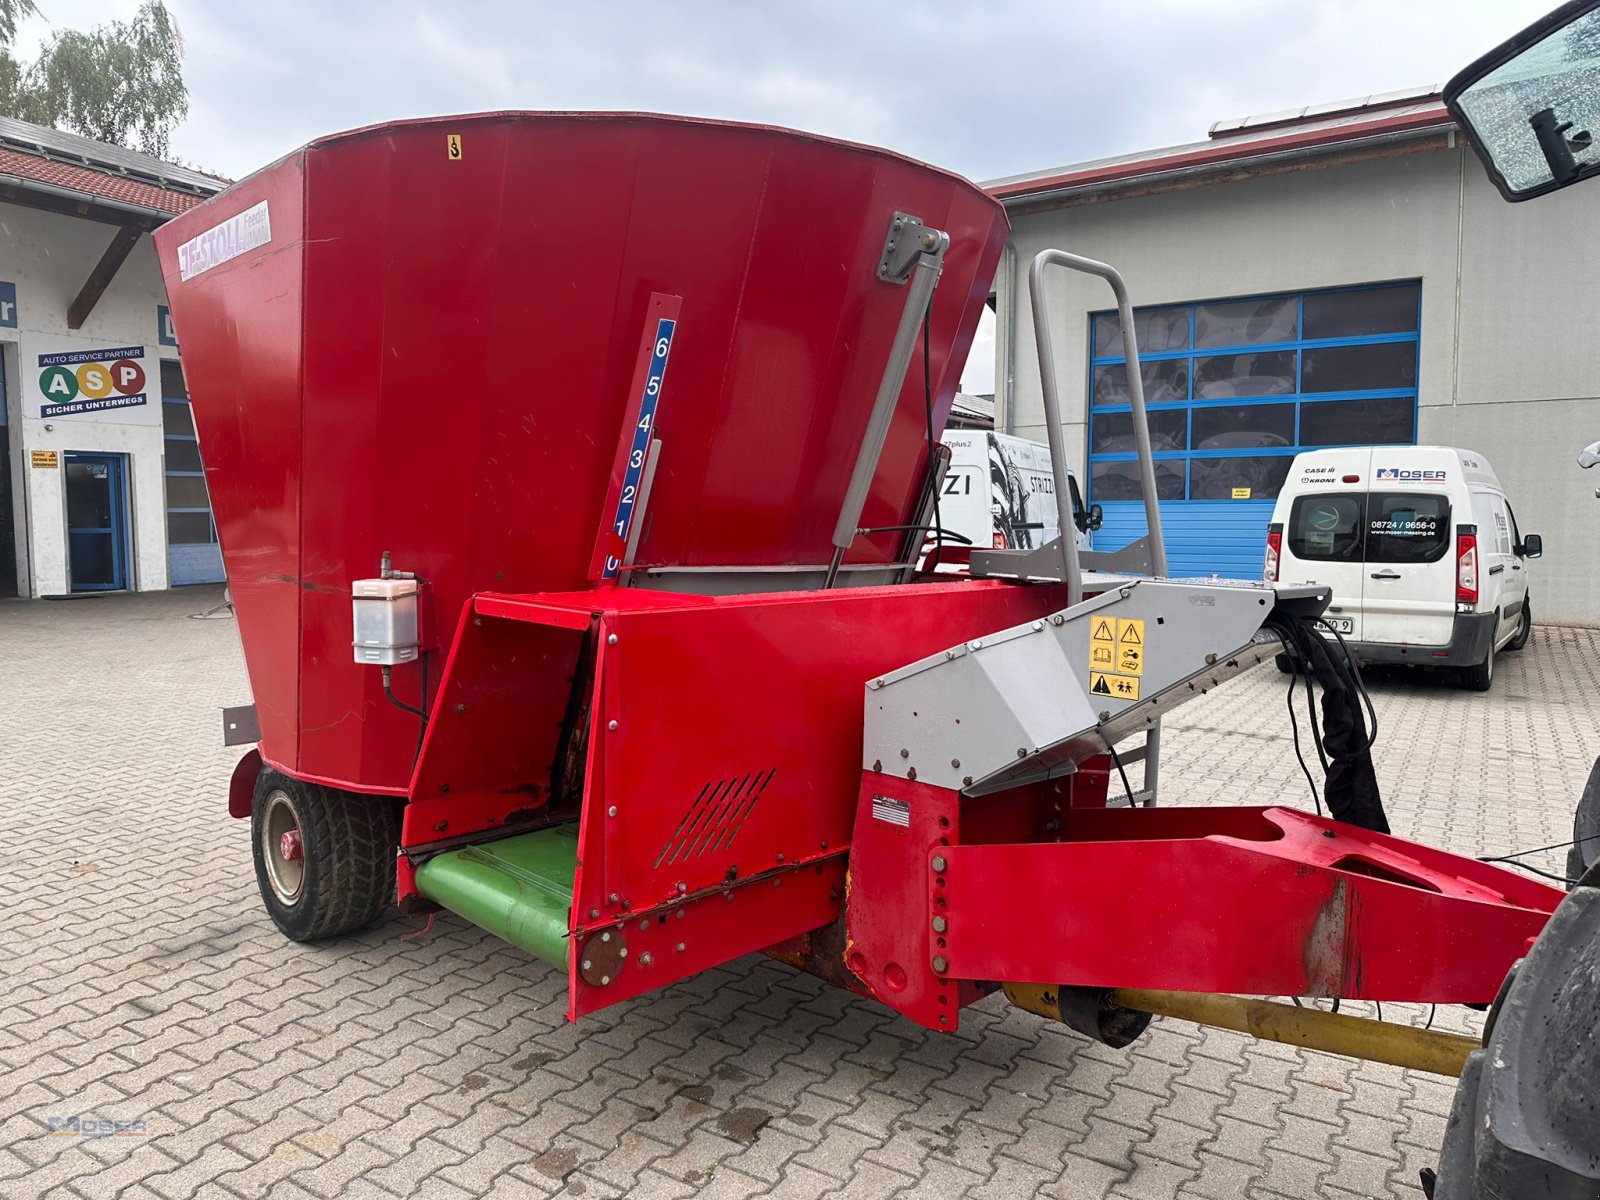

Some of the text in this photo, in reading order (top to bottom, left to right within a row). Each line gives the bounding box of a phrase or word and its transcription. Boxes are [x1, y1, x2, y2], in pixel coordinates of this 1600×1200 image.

[43, 349, 141, 364] AUTO SERVICE PARTNER
[655, 337, 669, 358] 6
[646, 375, 660, 396] 5
[45, 396, 143, 415] SICHER UNTERWEGS
[638, 413, 651, 433] 4
[630, 449, 643, 468] 3
[621, 485, 635, 504] 2
[1030, 476, 1054, 494] STRIZZI
[616, 520, 625, 536] 1
[1371, 521, 1436, 530] 08724 / 9656-0
